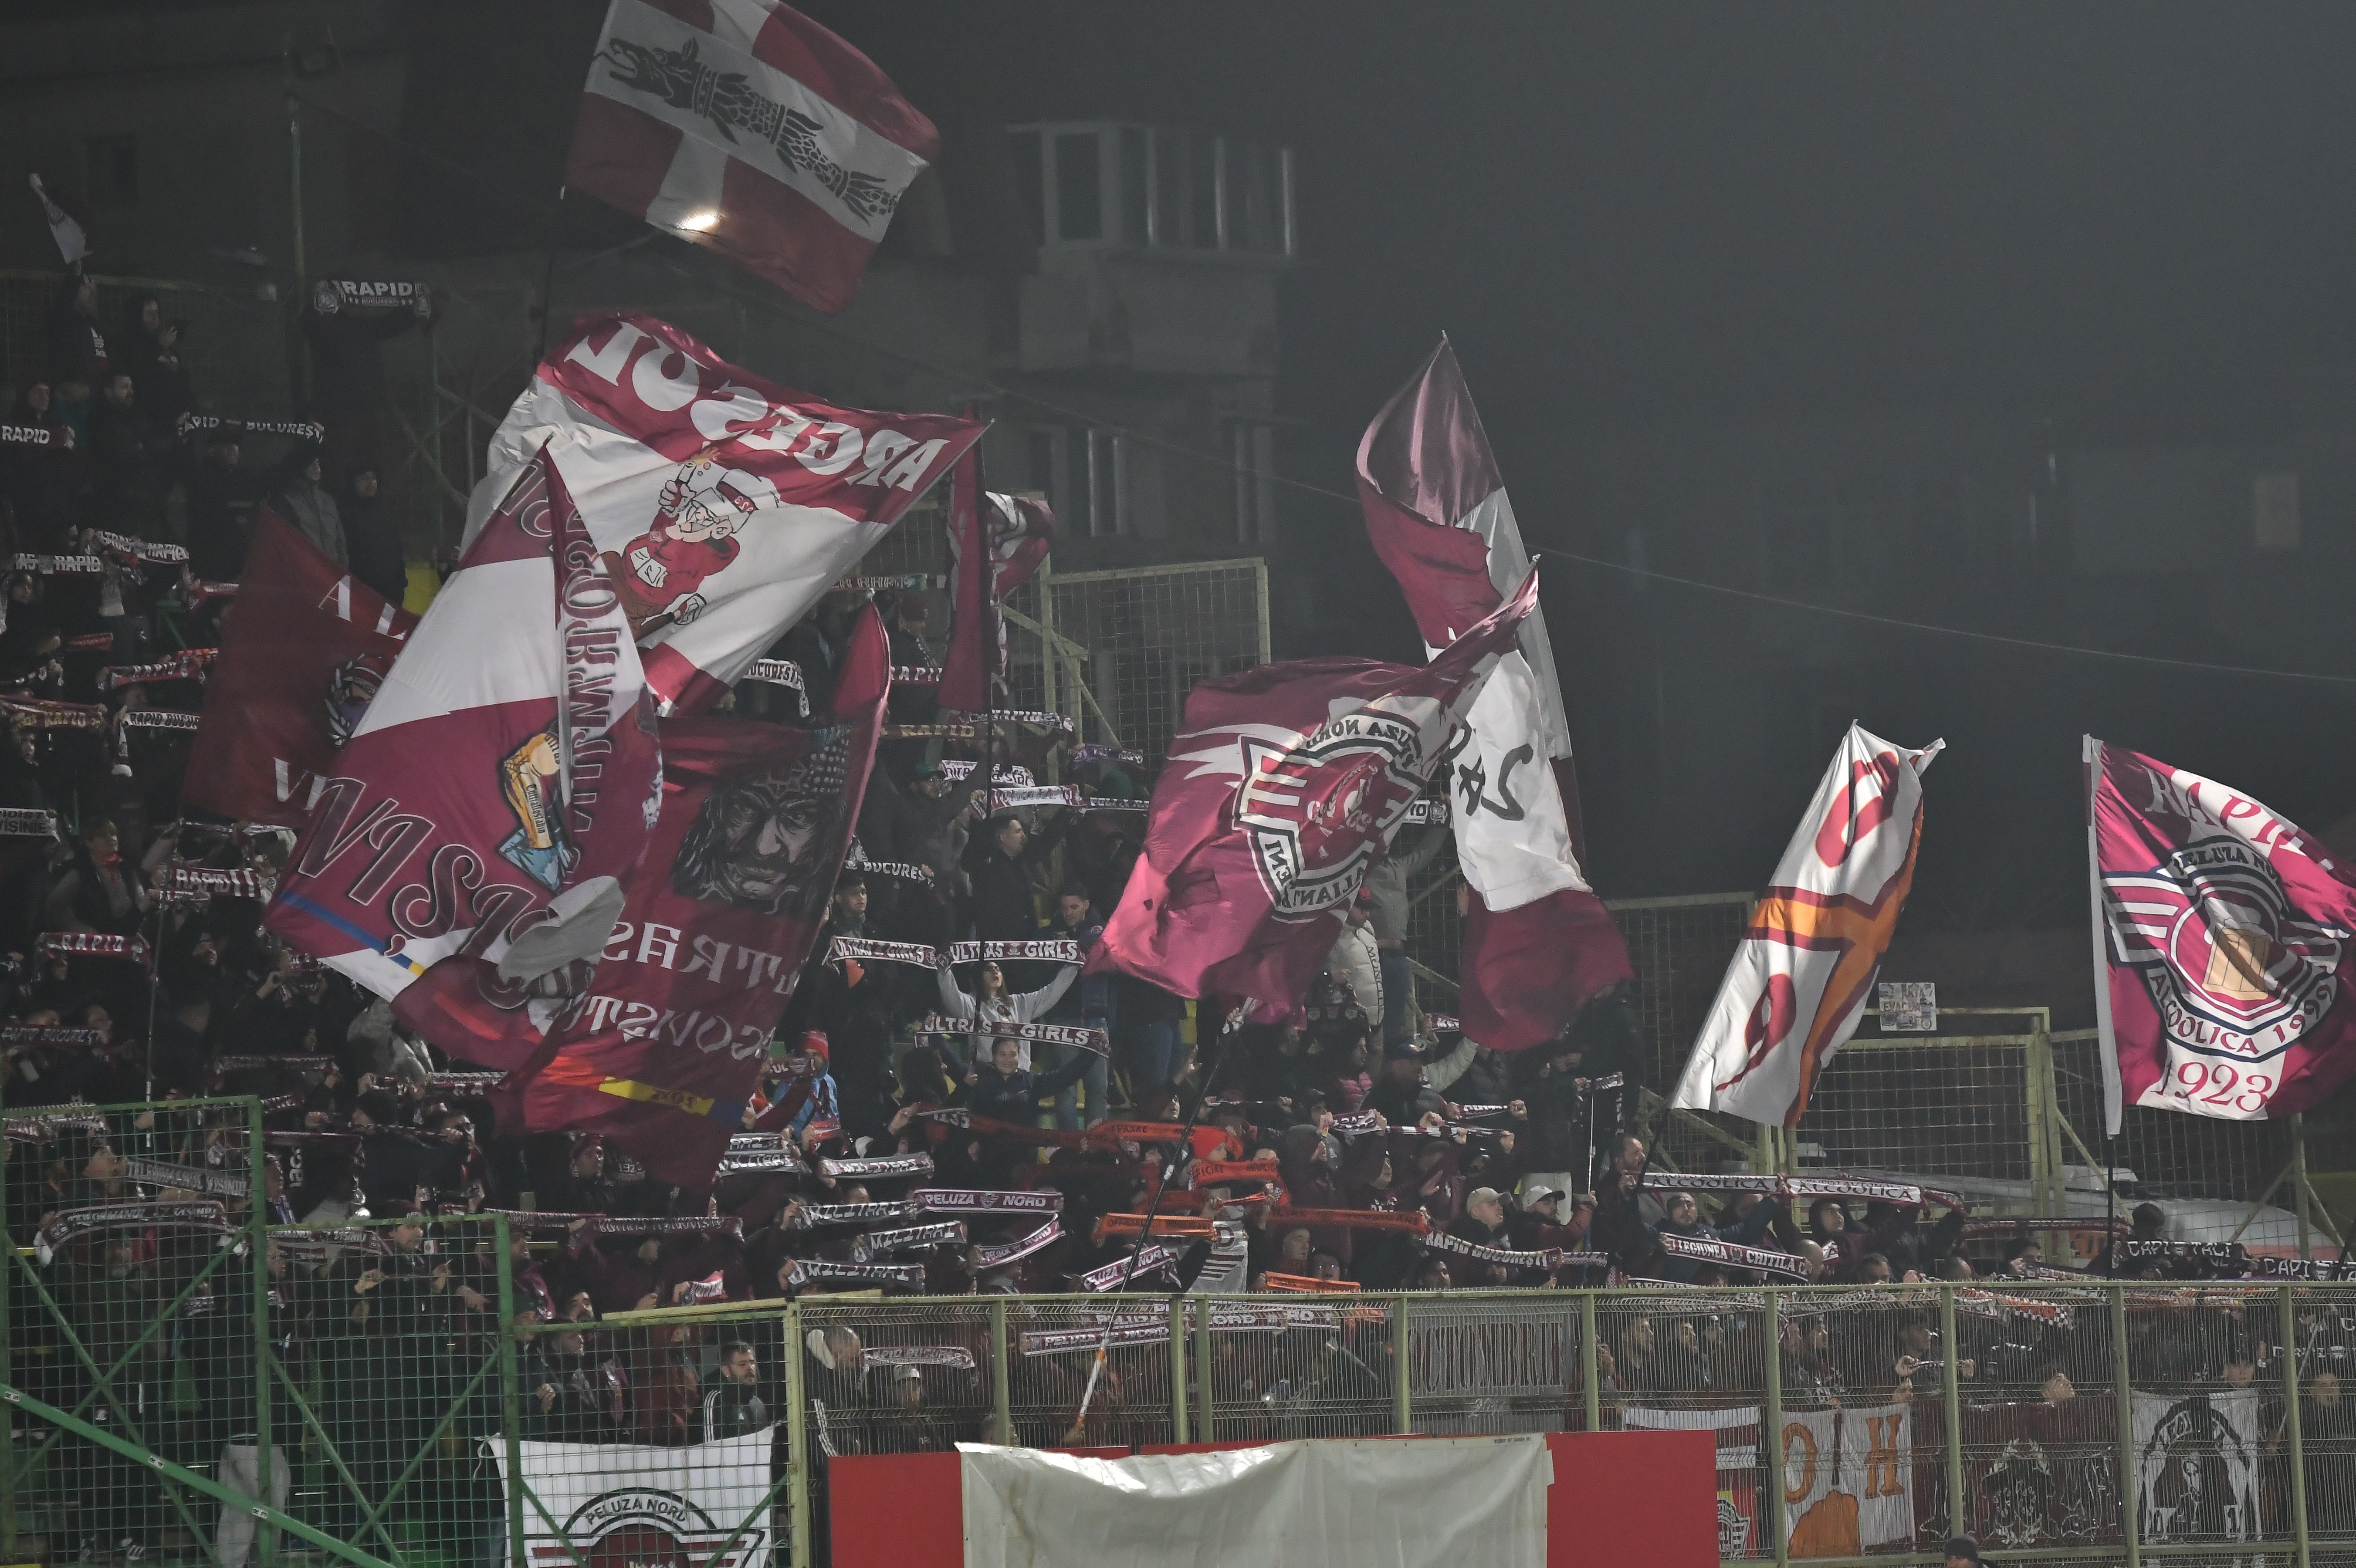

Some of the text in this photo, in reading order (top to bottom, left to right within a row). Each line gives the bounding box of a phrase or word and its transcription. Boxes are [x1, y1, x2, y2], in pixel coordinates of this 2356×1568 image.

[341, 280, 413, 297] RAPID
[2, 425, 50, 444] RAPID
[130, 712, 162, 727] RAPID
[175, 868, 231, 894] RAPID
[61, 934, 125, 953] RAPID
[836, 937, 924, 963] ULTRAS GIRLS
[1025, 941, 1078, 960] GIRLS
[2150, 973, 2260, 1054] ALCOOLICA
[1020, 1026, 1090, 1046] GIRLS
[2154, 1060, 2273, 1112] 1923
[1651, 1178, 1770, 1190] ALCOOLICA
[1798, 1183, 1914, 1201] ALCOOLICA
[925, 1193, 1046, 1207] PELUZA NORD
[872, 1223, 956, 1250] MILITARI
[1678, 1240, 1796, 1273] LEGIUNEA CHITILA
[807, 1263, 910, 1281] MILITARI
[584, 1498, 687, 1526] PELUZA NORD
